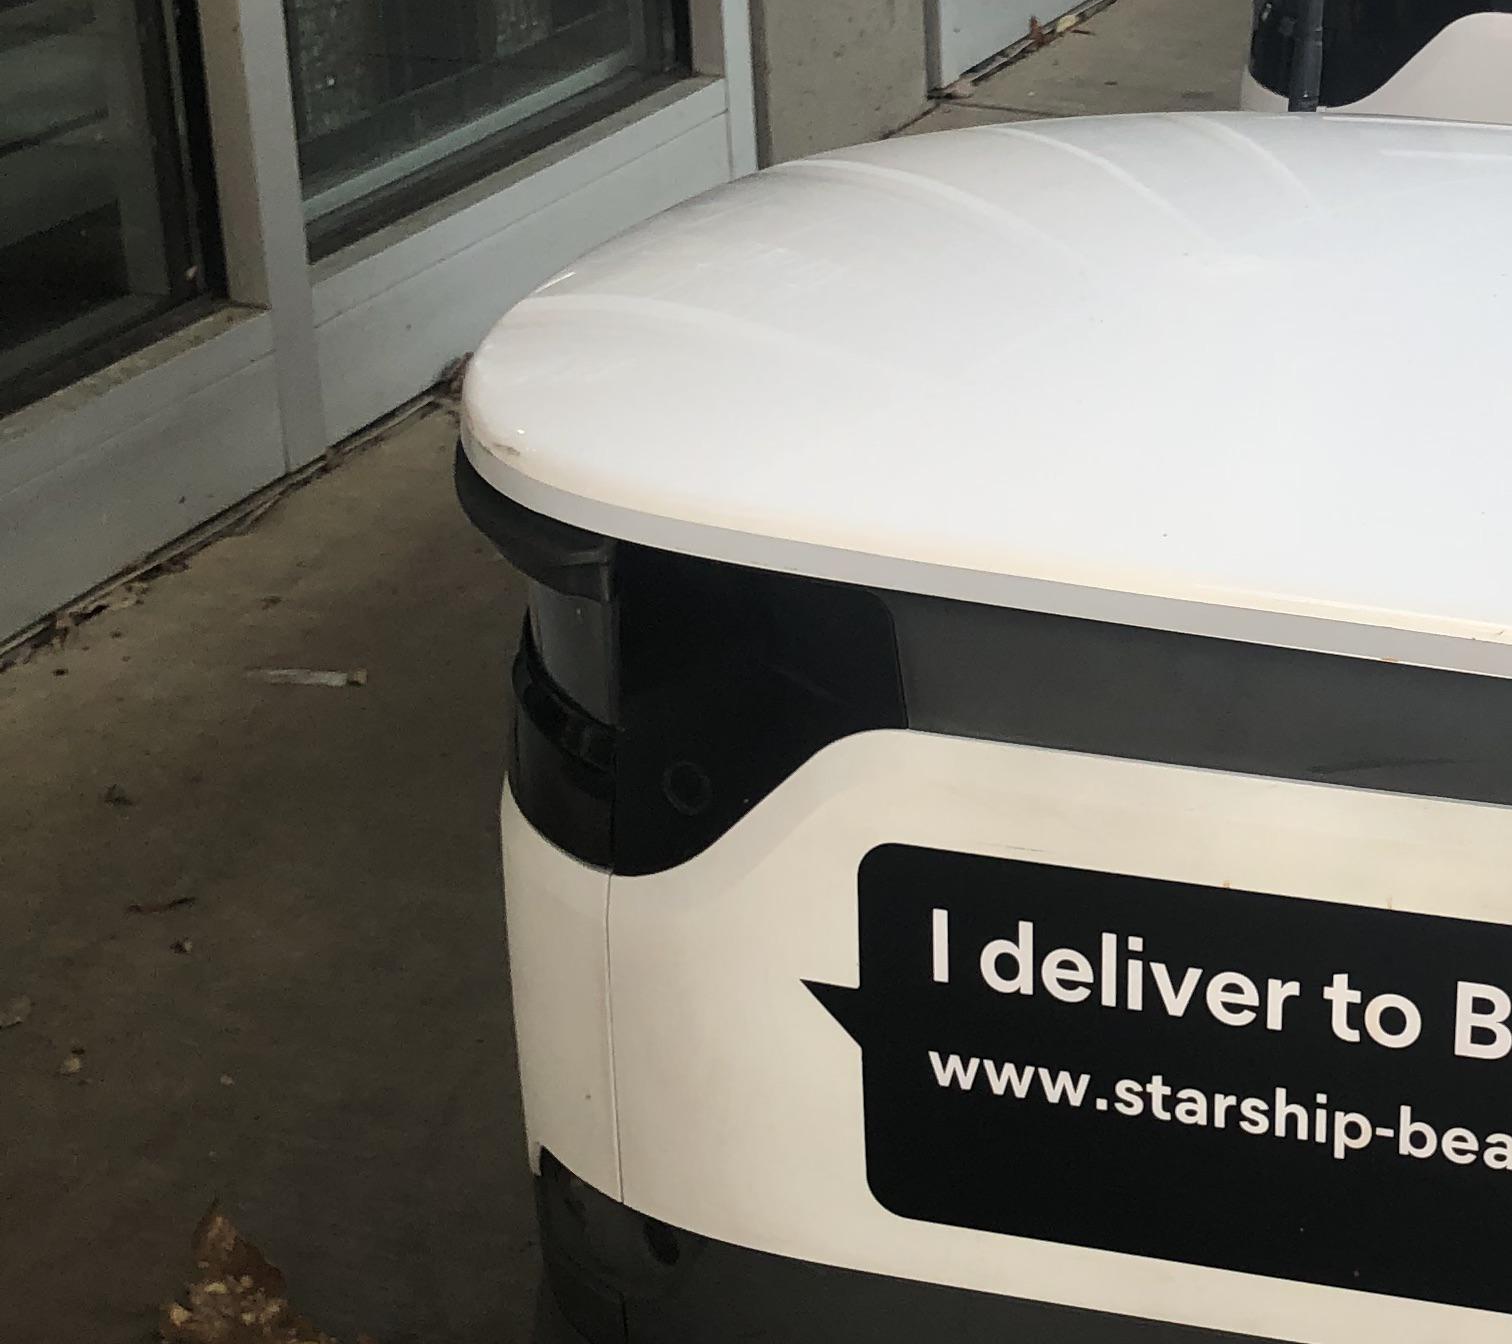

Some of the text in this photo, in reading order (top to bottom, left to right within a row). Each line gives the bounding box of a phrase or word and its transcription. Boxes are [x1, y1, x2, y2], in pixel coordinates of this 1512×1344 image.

[932, 908, 949, 983] I
[980, 920, 1301, 1031] deliver
[1323, 973, 1422, 1049] to
